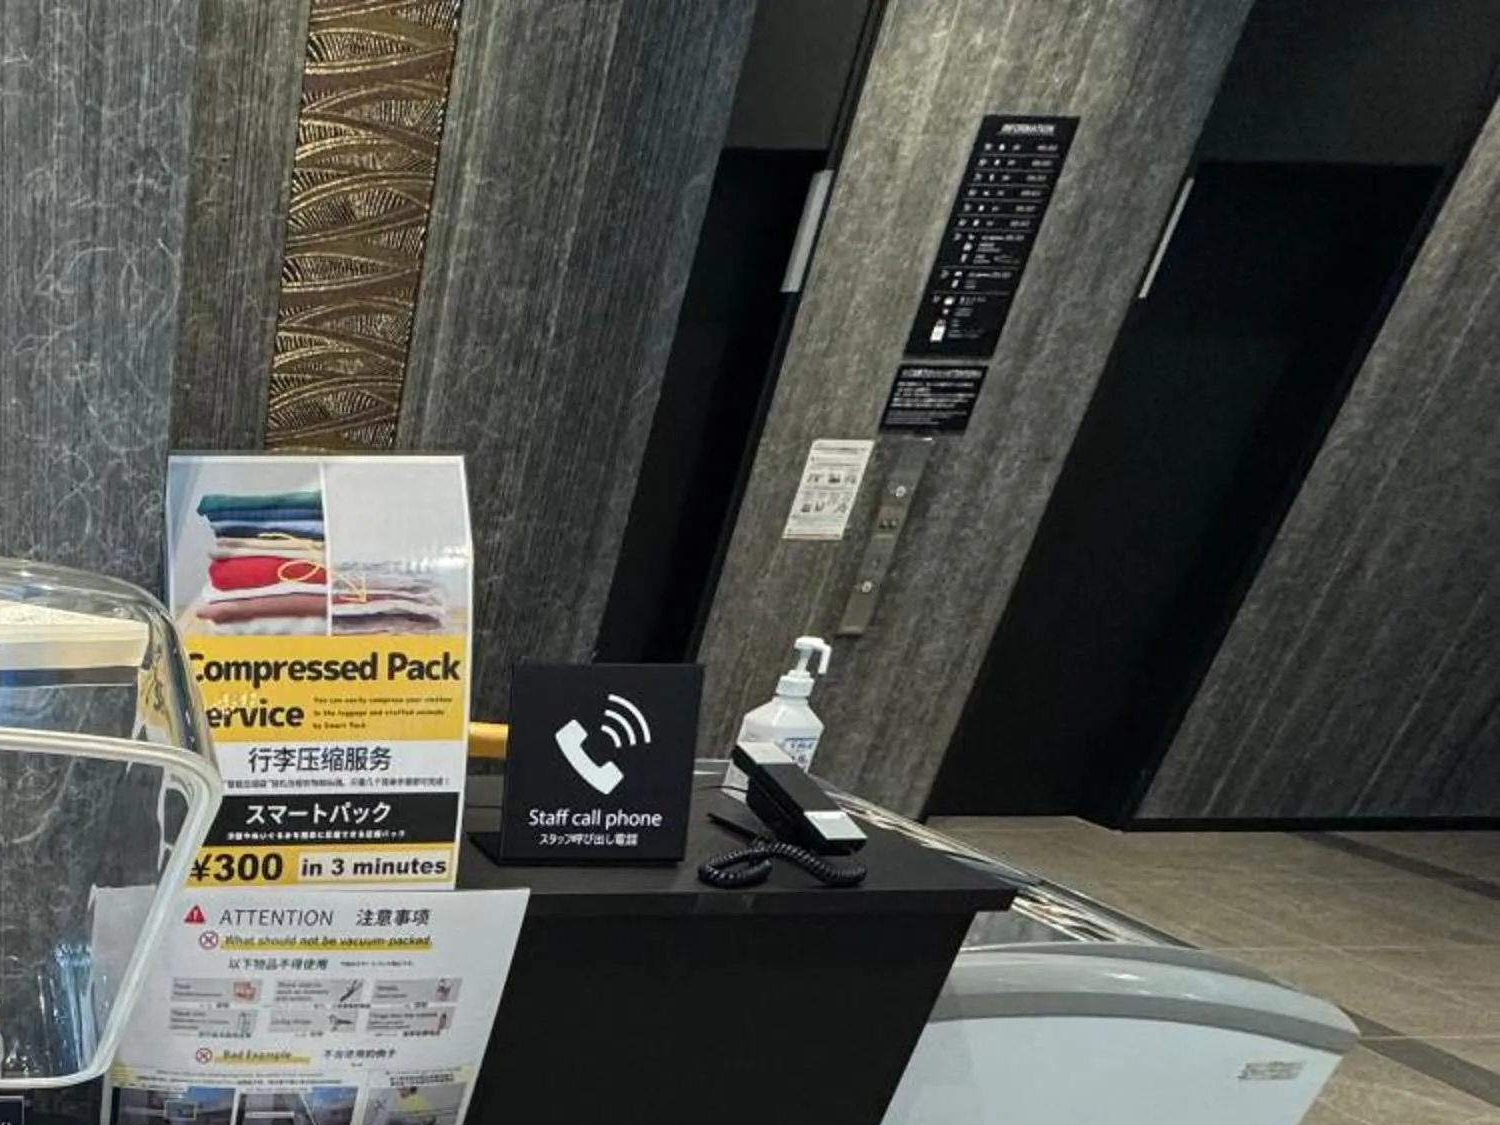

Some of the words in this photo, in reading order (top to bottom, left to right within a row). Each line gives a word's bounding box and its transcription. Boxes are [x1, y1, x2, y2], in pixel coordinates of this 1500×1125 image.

[388, 650, 461, 681] Pack
[205, 698, 304, 729] ervice
[250, 747, 392, 772] 行李压缩服务
[246, 801, 391, 824] スマートパック
[528, 808, 570, 827] Staff
[571, 808, 602, 827] call
[605, 808, 663, 831] phone
[190, 852, 284, 882] ¥300
[301, 858, 323, 877] in
[331, 859, 345, 877] 3
[353, 857, 448, 876] minutes
[219, 909, 335, 926] ATTENTION
[355, 908, 432, 927] 注意事项
[225, 934, 254, 946] What
[256, 934, 297, 946] should
[299, 934, 319, 946] not
[321, 934, 336, 946] be
